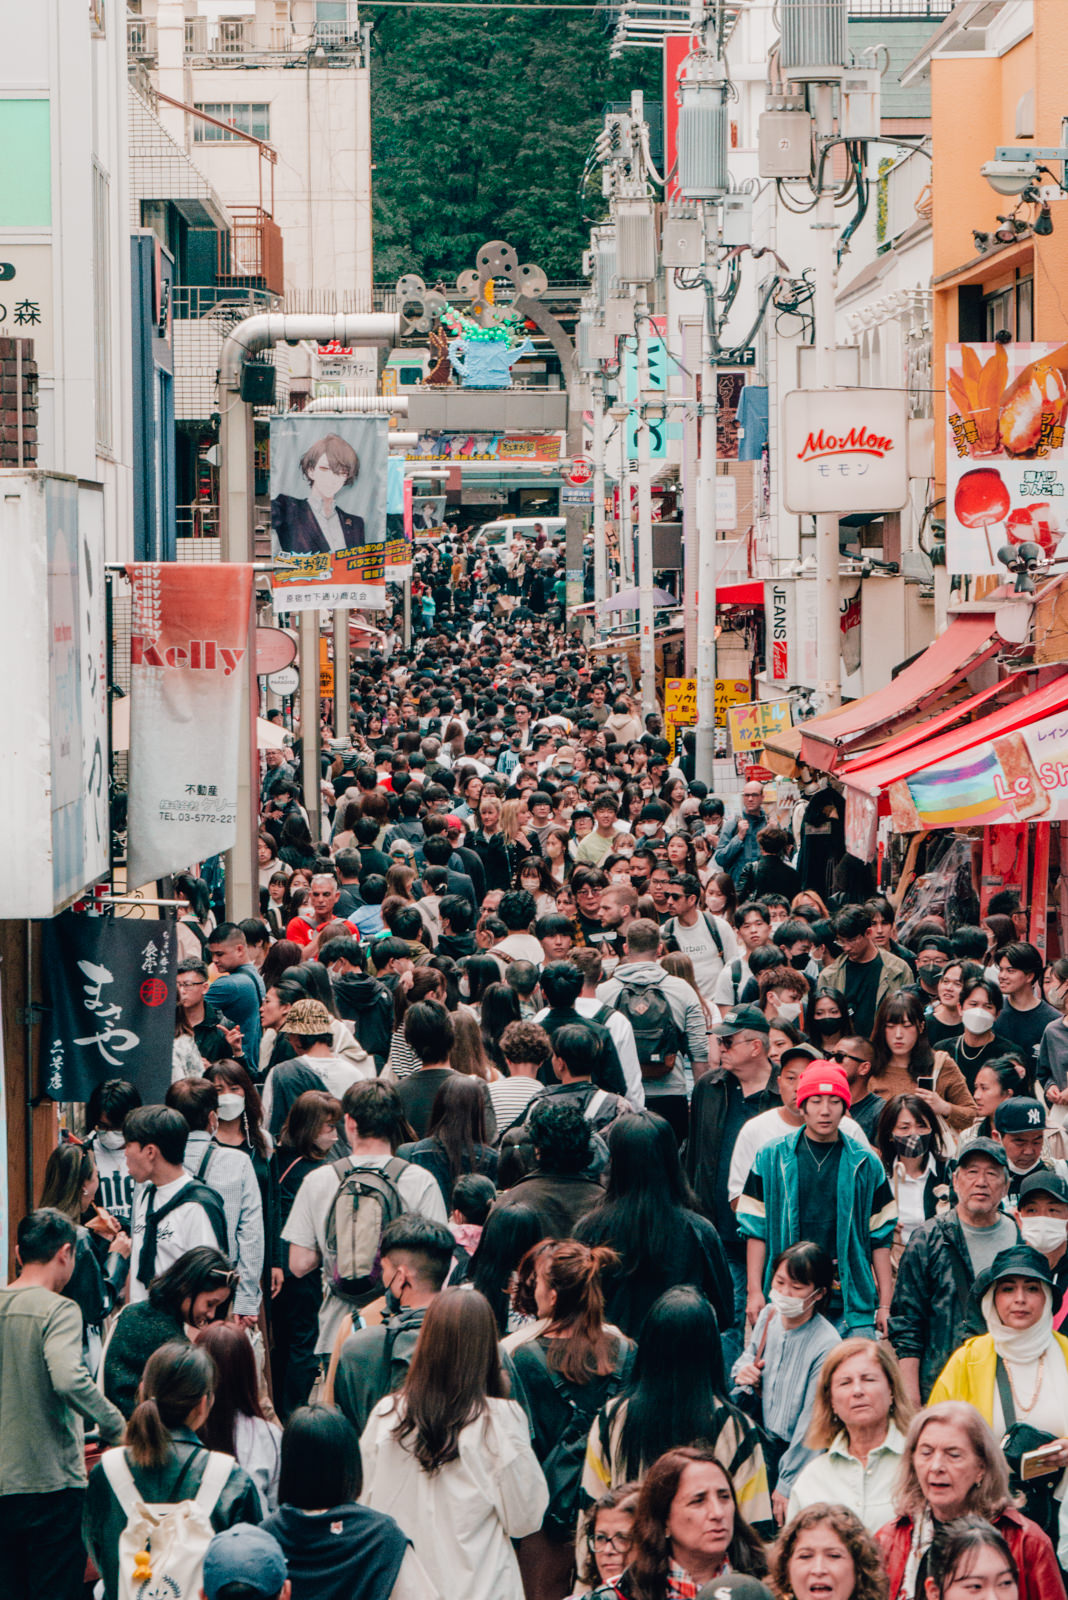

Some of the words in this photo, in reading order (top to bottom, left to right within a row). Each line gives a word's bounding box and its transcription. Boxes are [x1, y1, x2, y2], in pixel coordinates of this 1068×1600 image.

[948, 413, 970, 458] チップス
[817, 464, 870, 477] モモン
[348, 557, 384, 570] バラエティ
[773, 585, 787, 639] JEANS
[131, 634, 246, 676] Kelly
[734, 704, 786, 725] アイドル
[184, 784, 218, 797] 不動産
[993, 774, 1032, 801] Le
